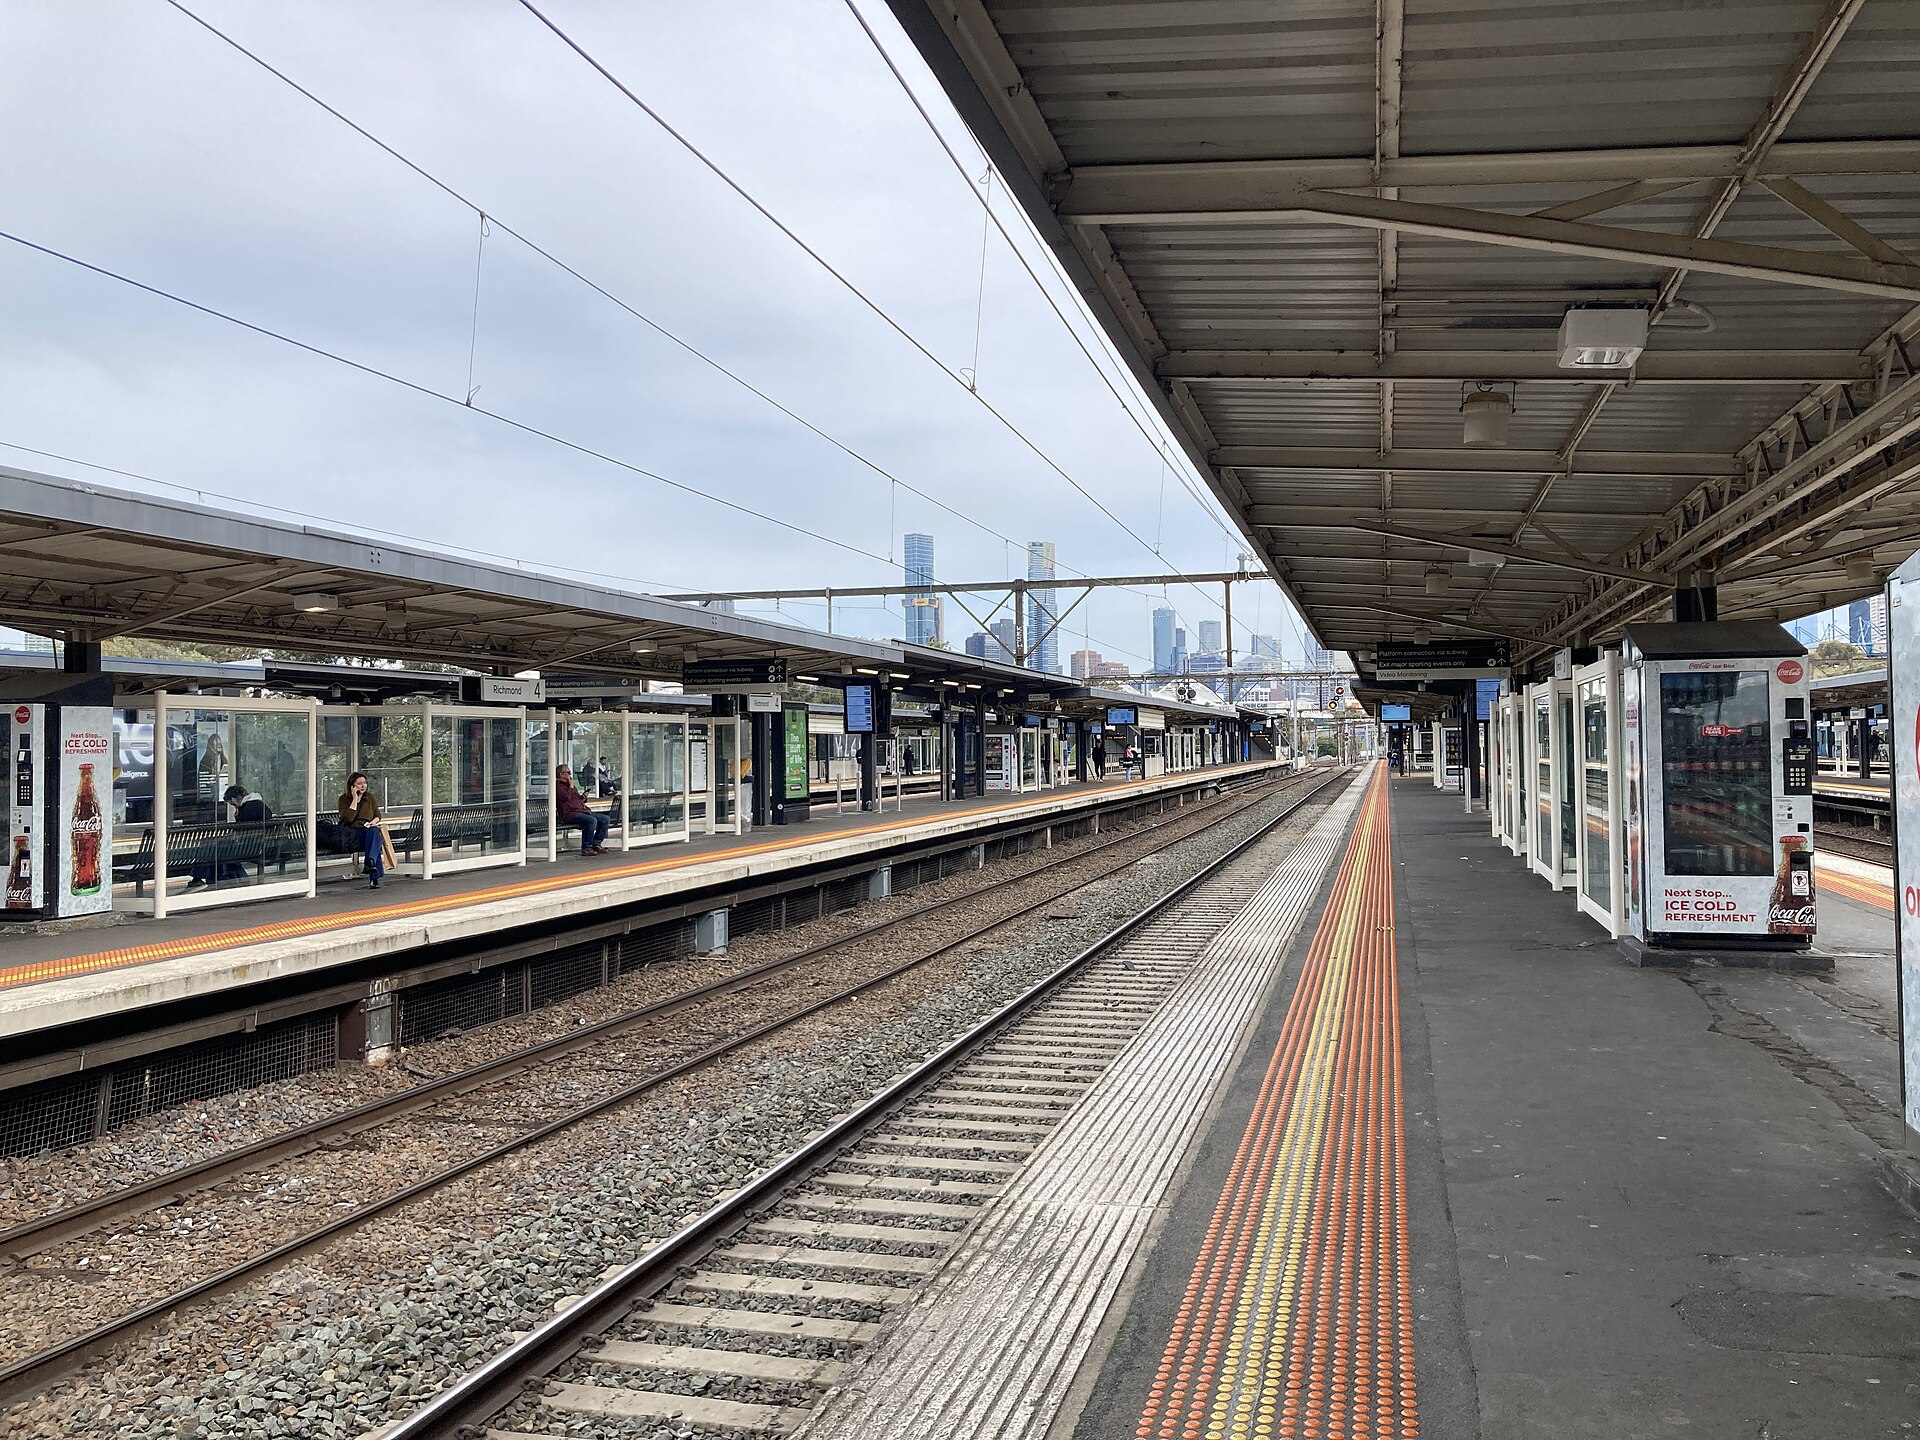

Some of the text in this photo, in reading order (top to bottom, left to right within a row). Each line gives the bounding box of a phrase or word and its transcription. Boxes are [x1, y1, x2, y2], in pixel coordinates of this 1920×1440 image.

[1453, 659, 1465, 667] only
[1777, 668, 1801, 676] Coca-Cola
[493, 684, 522, 695] Richmond
[534, 682, 541, 698] 4
[184, 711, 191, 722] 2
[65, 740, 108, 748] ICE COLD
[1664, 889, 1732, 899] Next Stop...
[1665, 900, 1737, 911] ICE COLD
[1665, 913, 1756, 922] REFRESHMENT
